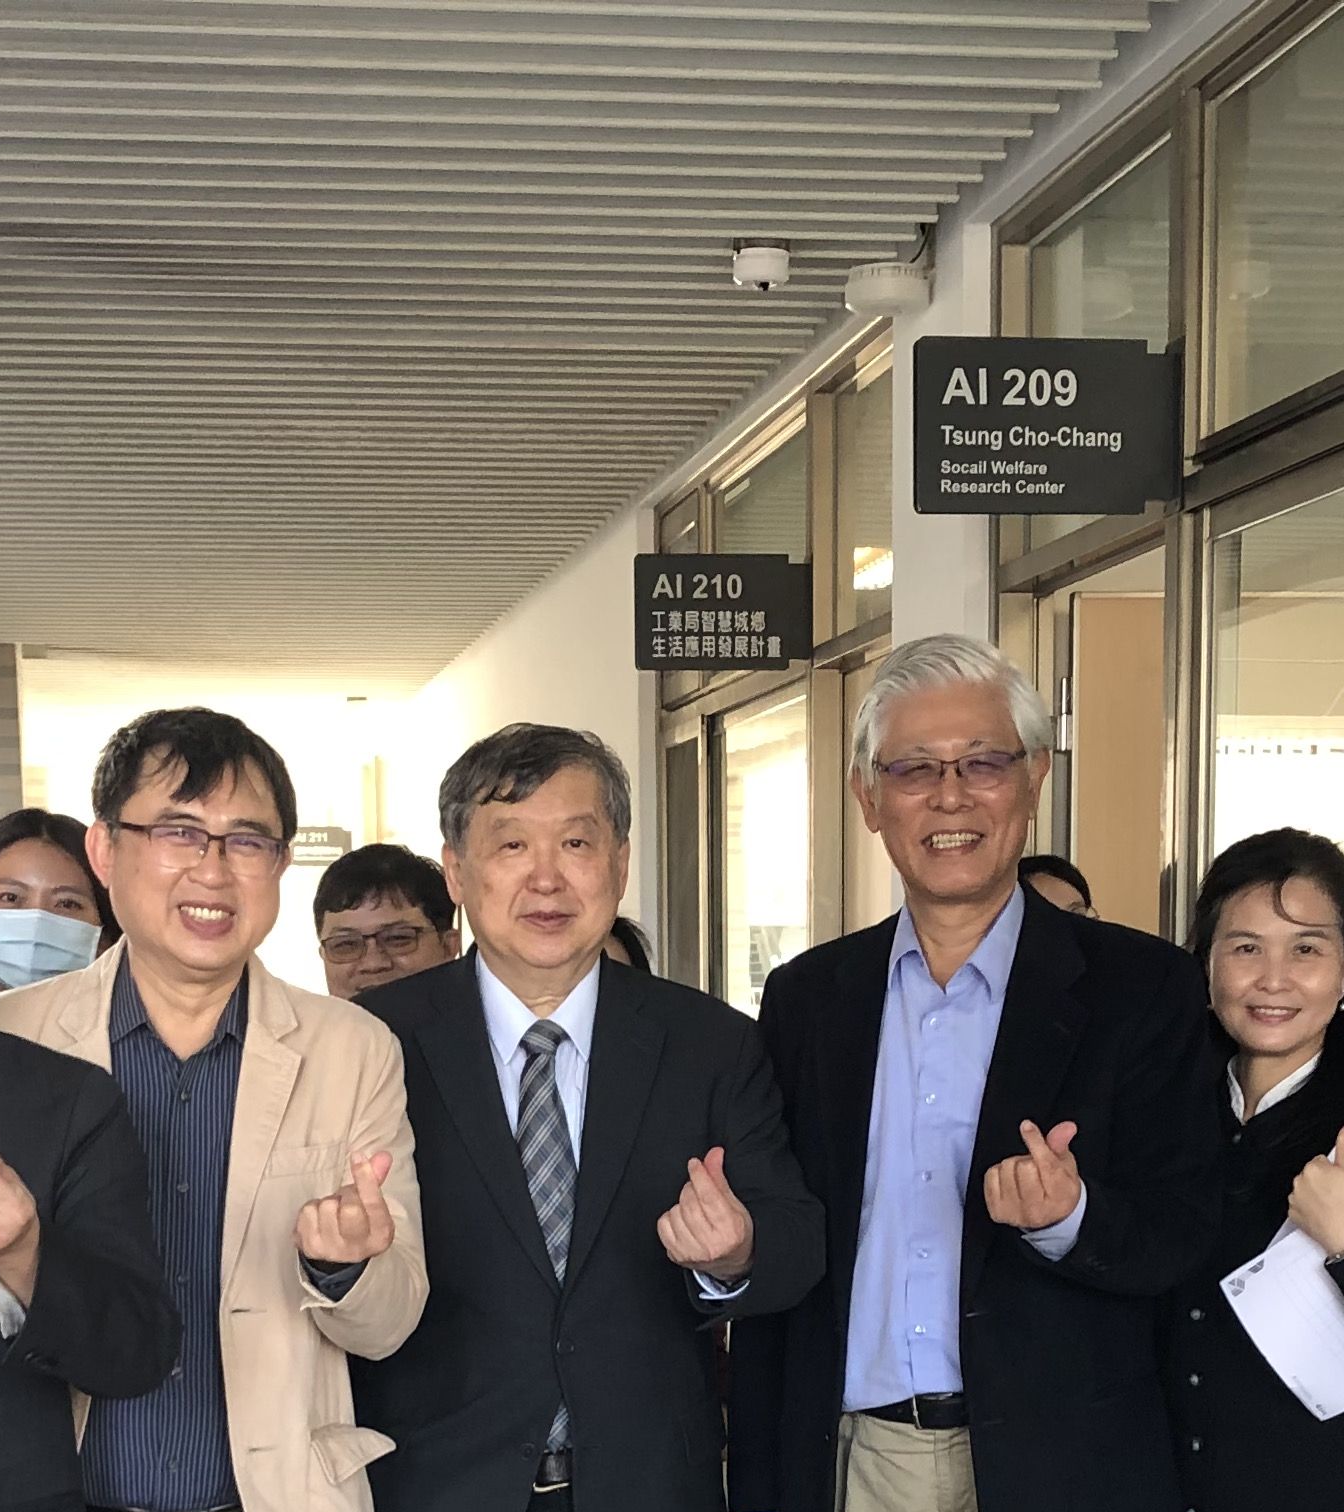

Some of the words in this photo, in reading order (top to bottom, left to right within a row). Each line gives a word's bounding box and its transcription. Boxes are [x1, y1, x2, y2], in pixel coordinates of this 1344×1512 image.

[941, 367, 988, 405] AI
[1002, 368, 1078, 407] 209
[940, 425, 1003, 450] Tsung
[1009, 426, 1122, 452] Cho-Chang
[940, 460, 987, 474] Socail
[991, 461, 1048, 475] Welfare
[940, 480, 1011, 494] Research
[1015, 480, 1065, 494] Center
[652, 574, 683, 599] AI
[692, 574, 743, 599] 210
